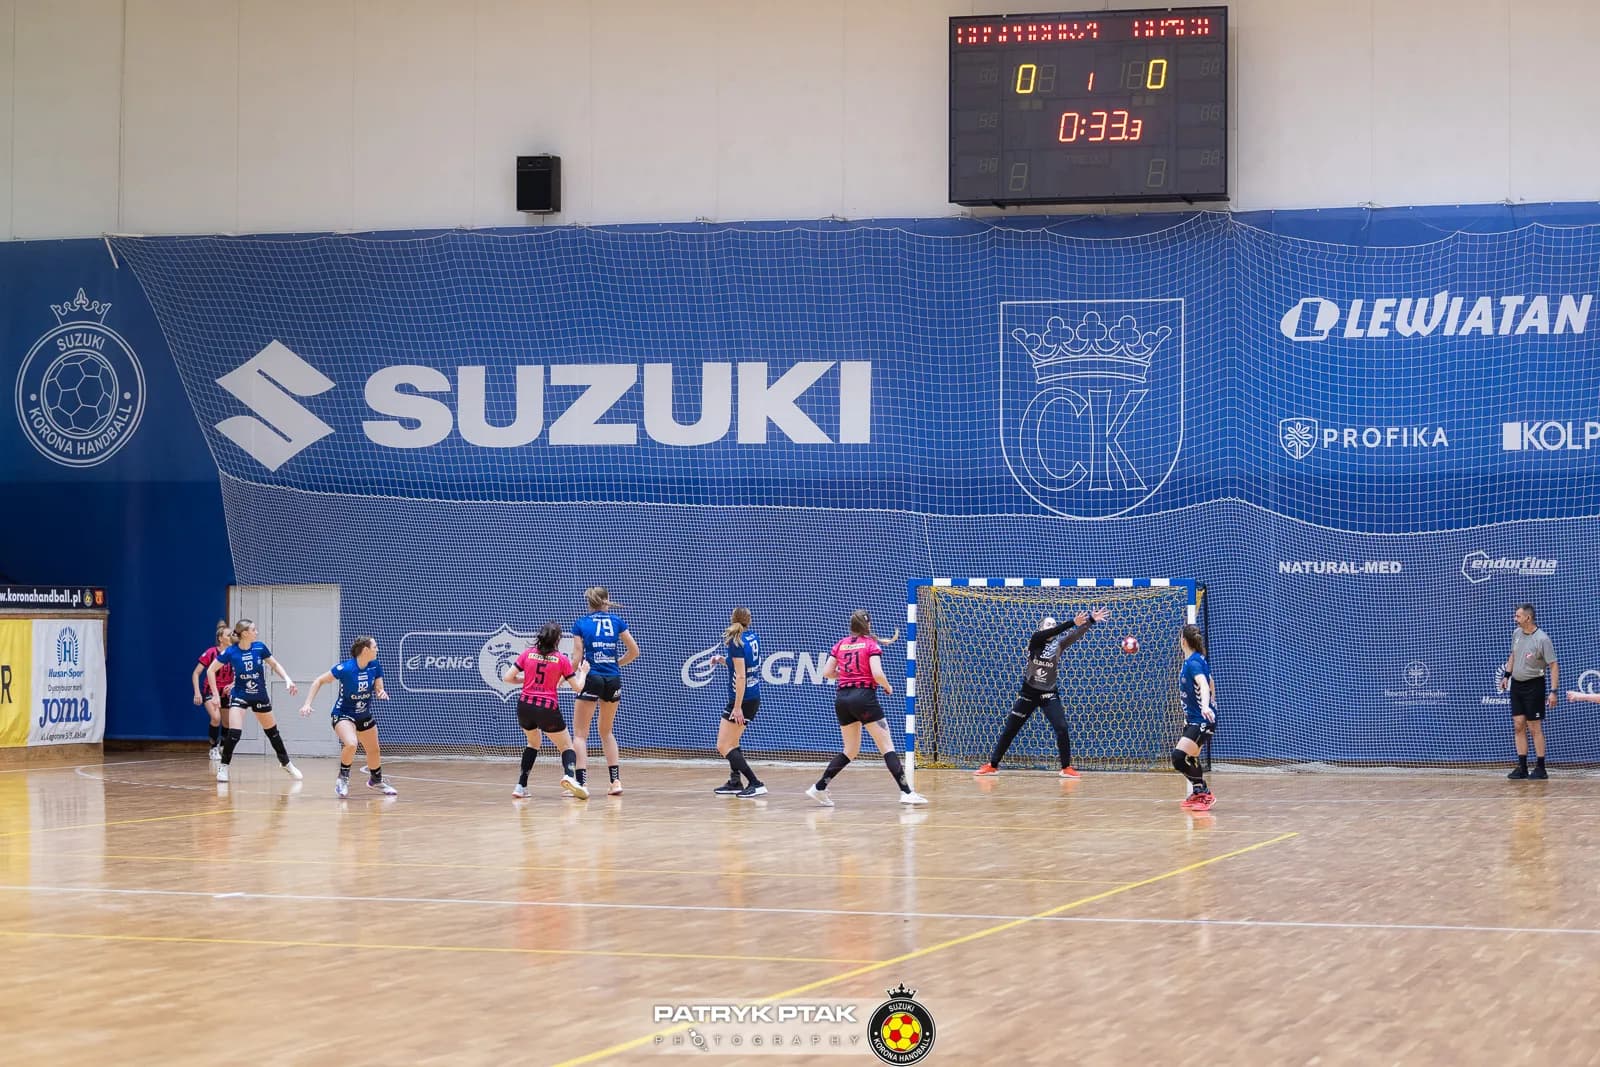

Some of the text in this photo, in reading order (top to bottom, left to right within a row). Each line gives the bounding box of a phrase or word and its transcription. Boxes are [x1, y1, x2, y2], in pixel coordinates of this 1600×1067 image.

[1016, 64, 1037, 94] 0
[1147, 59, 1167, 90] 0
[1058, 110, 1143, 143] 0:33.3
[1343, 290, 1593, 338] LEWIATAN
[56, 333, 105, 351] SUZUKI
[362, 361, 872, 449] SUZUKI
[28, 405, 133, 455] KORONA HANDBALL
[1323, 427, 1449, 449] PROFIKA
[1278, 561, 1402, 574] NATURAL-MED
[1471, 557, 1557, 569] endorfina
[592, 617, 615, 637] 79
[425, 656, 473, 669] PGNiG
[843, 651, 860, 673] 21
[534, 662, 547, 685] 5
